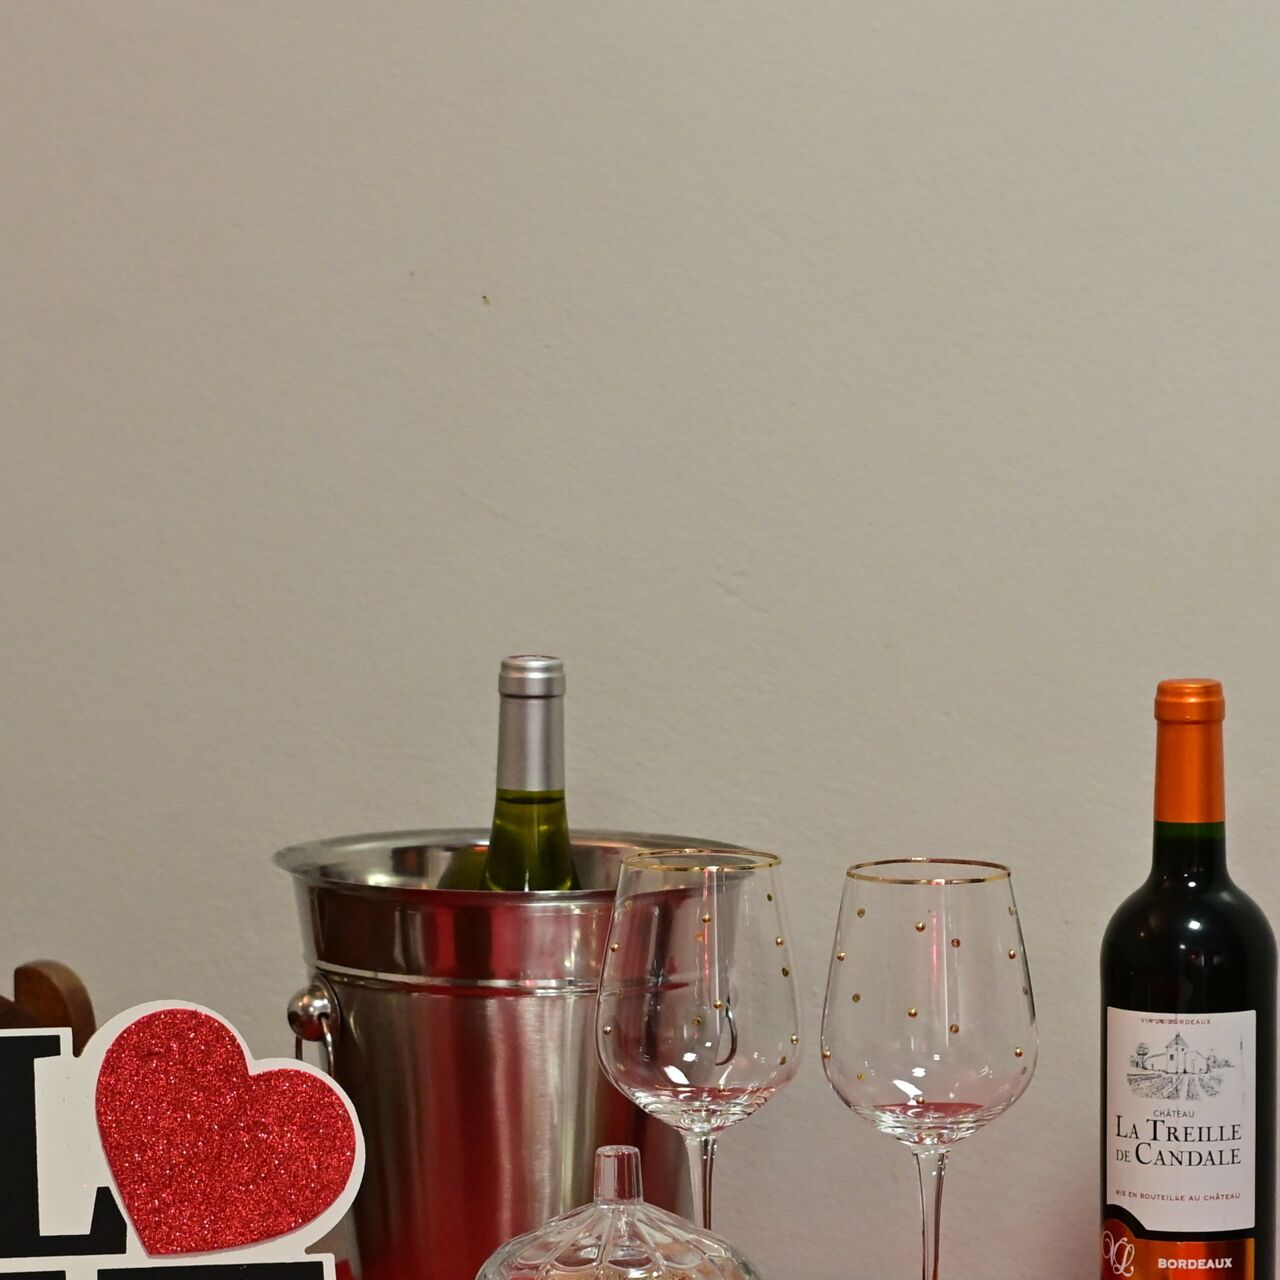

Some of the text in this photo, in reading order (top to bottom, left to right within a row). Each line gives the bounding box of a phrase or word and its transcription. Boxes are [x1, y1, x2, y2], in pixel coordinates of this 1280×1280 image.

[1153, 1109, 1195, 1119] CHÂTEAU
[1115, 1114, 1242, 1143] LA TREILLE
[1116, 1142, 1242, 1167] DE CANDALE
[1203, 1192, 1241, 1201] CHÂTEAU
[1158, 1258, 1233, 1269] BORDEAUX
